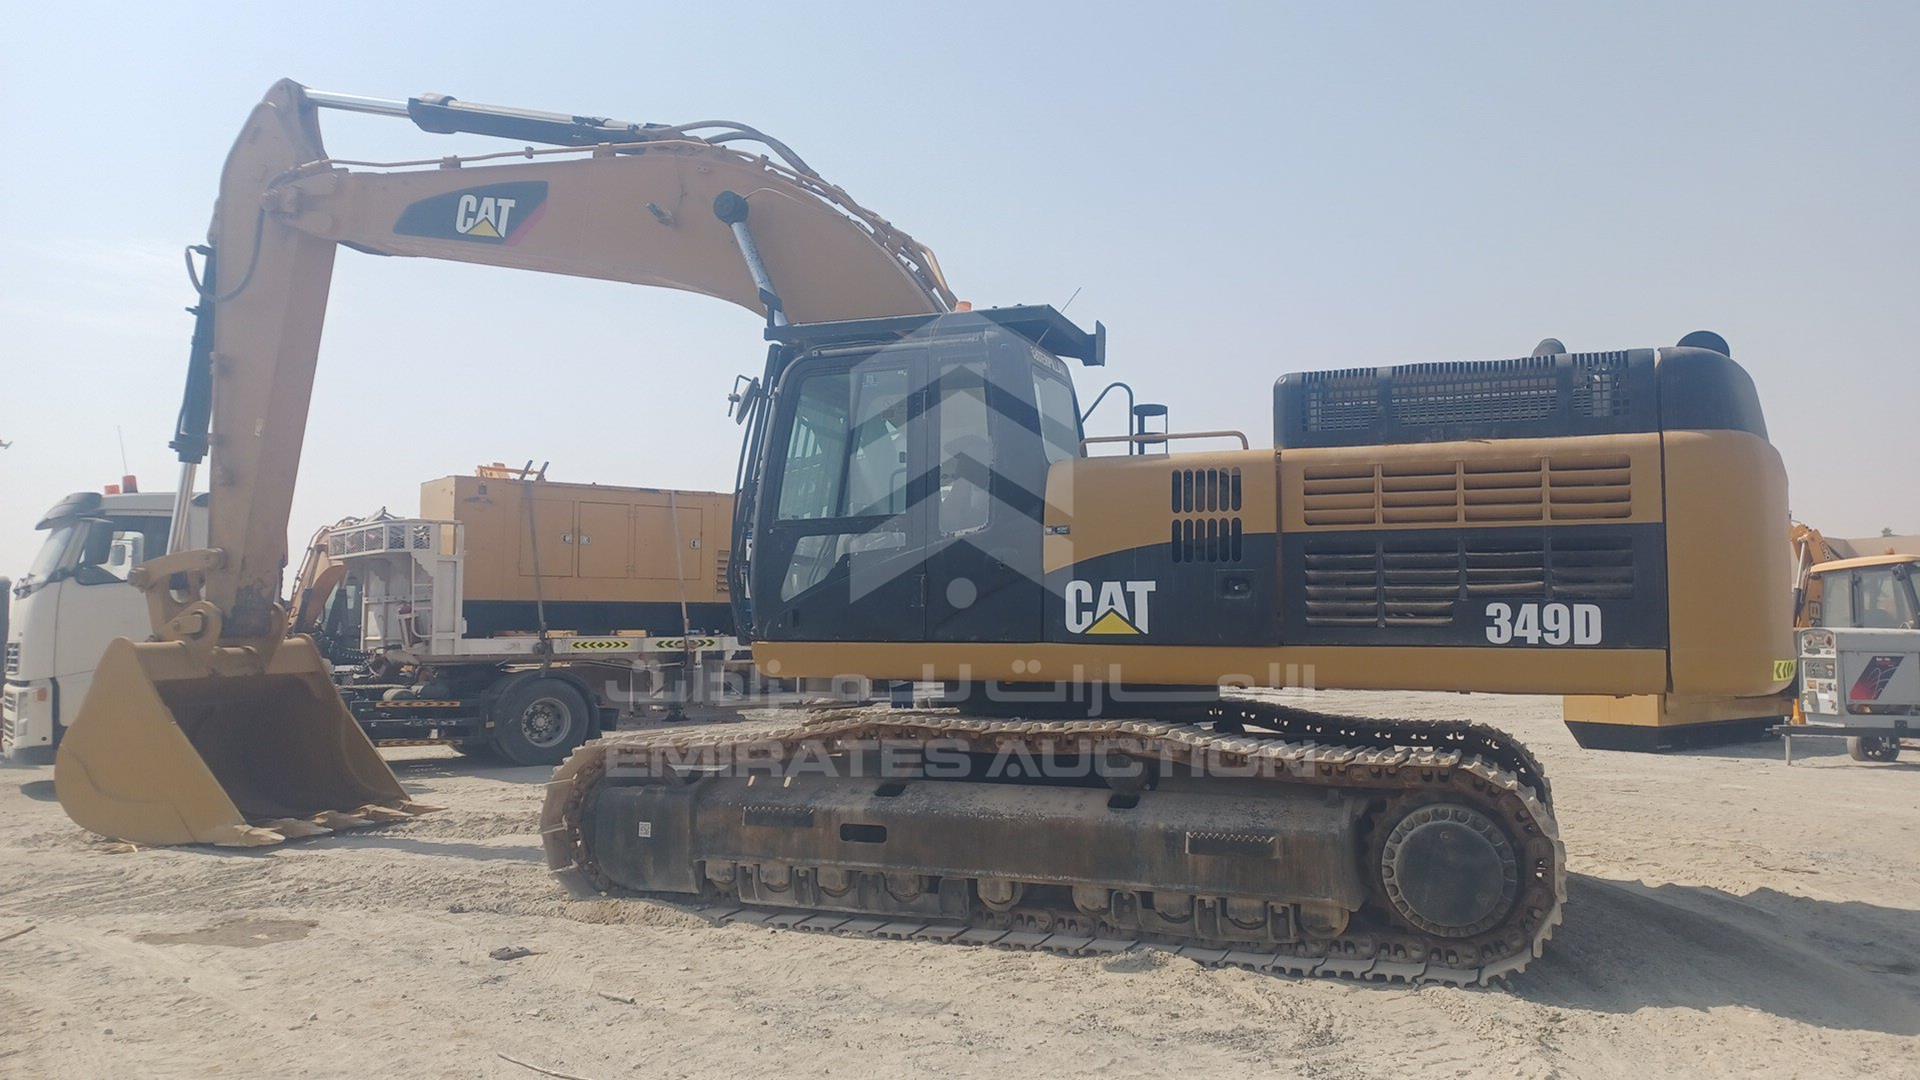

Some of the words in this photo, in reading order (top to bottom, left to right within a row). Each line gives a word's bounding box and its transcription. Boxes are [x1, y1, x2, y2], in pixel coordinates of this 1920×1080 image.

[455, 194, 516, 238] CAT
[1065, 579, 1156, 635] CAT
[1485, 602, 1602, 645] 349D
